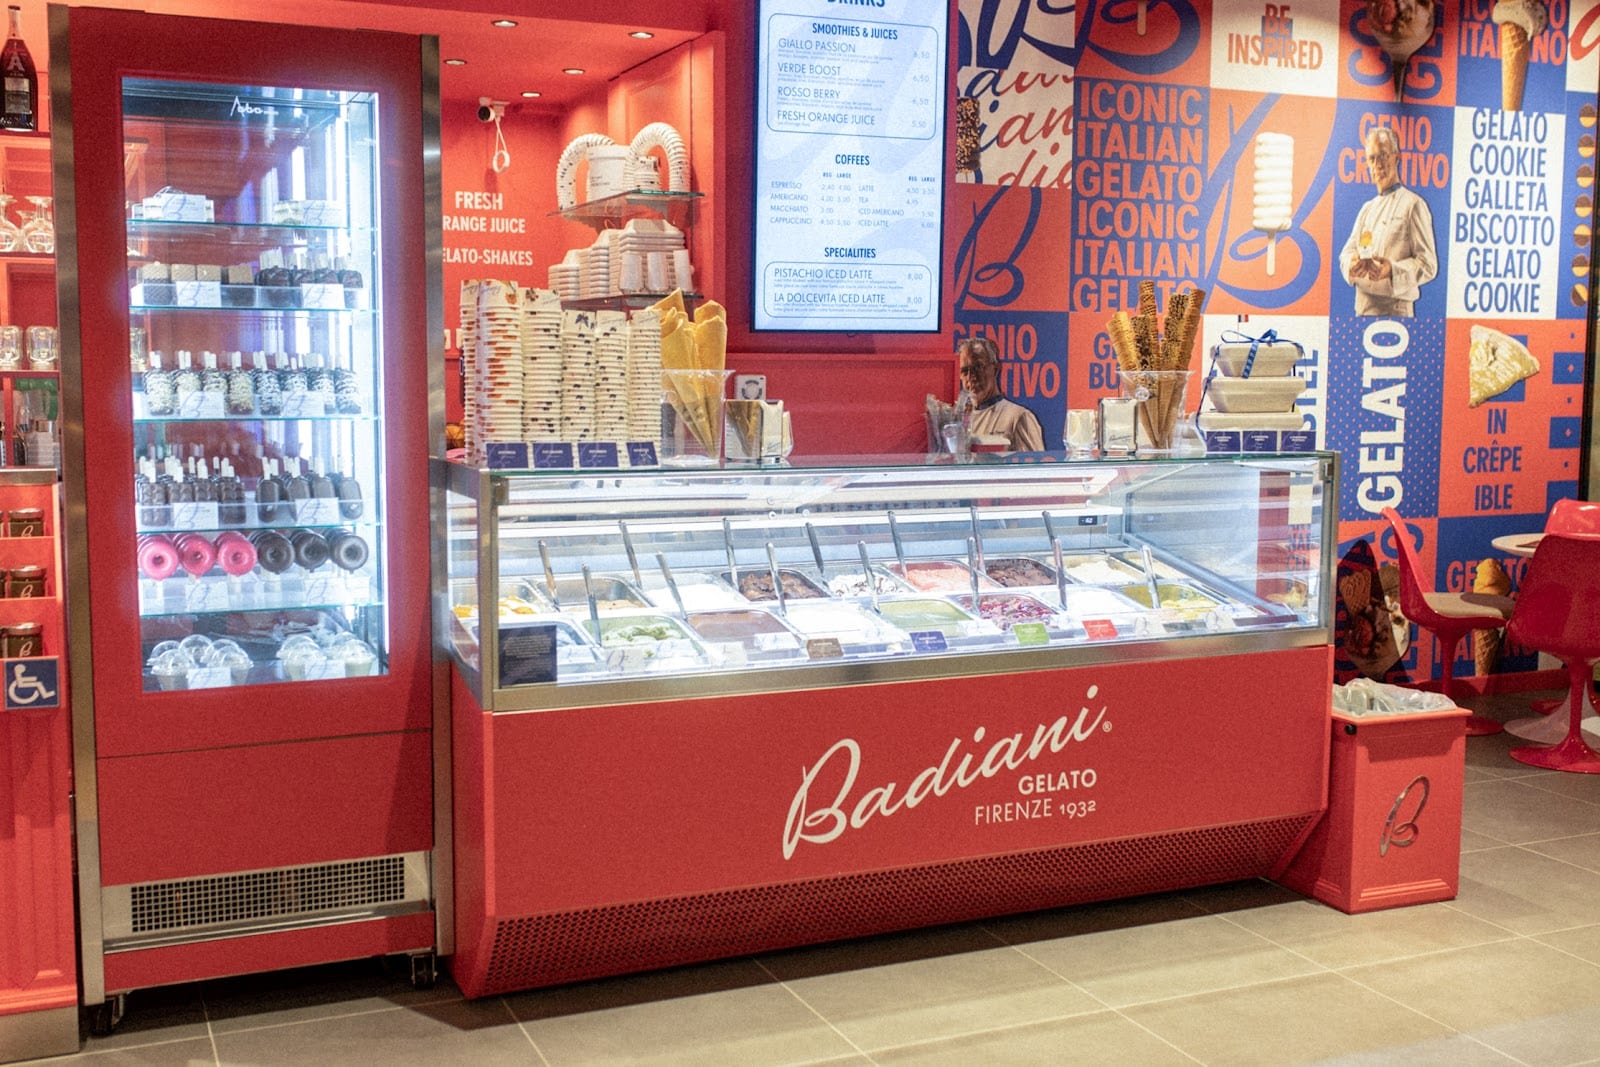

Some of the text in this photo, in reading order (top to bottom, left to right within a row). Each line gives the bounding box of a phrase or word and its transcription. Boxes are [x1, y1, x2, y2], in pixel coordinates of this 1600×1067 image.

[812, 22, 898, 40] SMOOTHIES & JUICES
[1264, 4, 1291, 35] BE
[778, 38, 856, 53] GIALLO PASSION
[1228, 33, 1323, 70] INSPIRED
[1461, 21, 1567, 66] ITANO
[777, 62, 841, 76] VERDE BOOST
[777, 86, 840, 99] ROSSO BERRY
[1079, 81, 1202, 126] ICONIC
[777, 110, 875, 126] FRESH ORANGE JUICE
[1473, 108, 1548, 145] GELATO
[1076, 121, 1203, 164] ITALIAN
[835, 154, 870, 166] COFFEES
[1338, 147, 1449, 189] CRTIVO
[1469, 144, 1547, 178] COOKIE
[1075, 160, 1202, 203] GELATO
[1465, 178, 1548, 212] GALLETA
[455, 191, 503, 211] FRESH
[770, 193, 808, 201] AMERICANO
[770, 205, 808, 213] MACCHIATO
[442, 215, 526, 234] RANGE JUICE
[770, 216, 812, 225] CAPPUCCINO
[872, 208, 904, 216] AMERICANO
[1078, 200, 1200, 241] ICONIC
[1455, 212, 1555, 247] BISCOTTO
[442, 248, 533, 266] LATO-SHAKES
[824, 247, 876, 259] SPECIALITIES
[1074, 239, 1200, 278] ITALIAN
[1466, 247, 1541, 280] GELATO
[774, 268, 873, 280] PISTACHIO ICED LATTE
[774, 293, 886, 304] LA DOLCEVITA ICED LATTE
[1073, 278, 1197, 314] GELT
[1464, 282, 1540, 313] COOKIE
[1357, 320, 1410, 514] GELATO
[1487, 409, 1507, 435] IN
[1463, 440, 1522, 473] CRÊPE
[1475, 484, 1513, 511] IBLE
[1446, 557, 1530, 594] GETO
[783, 685, 1107, 860] Badiani
[1018, 768, 1097, 796] GELATO
[975, 799, 1097, 825] FIRENZE 1932
